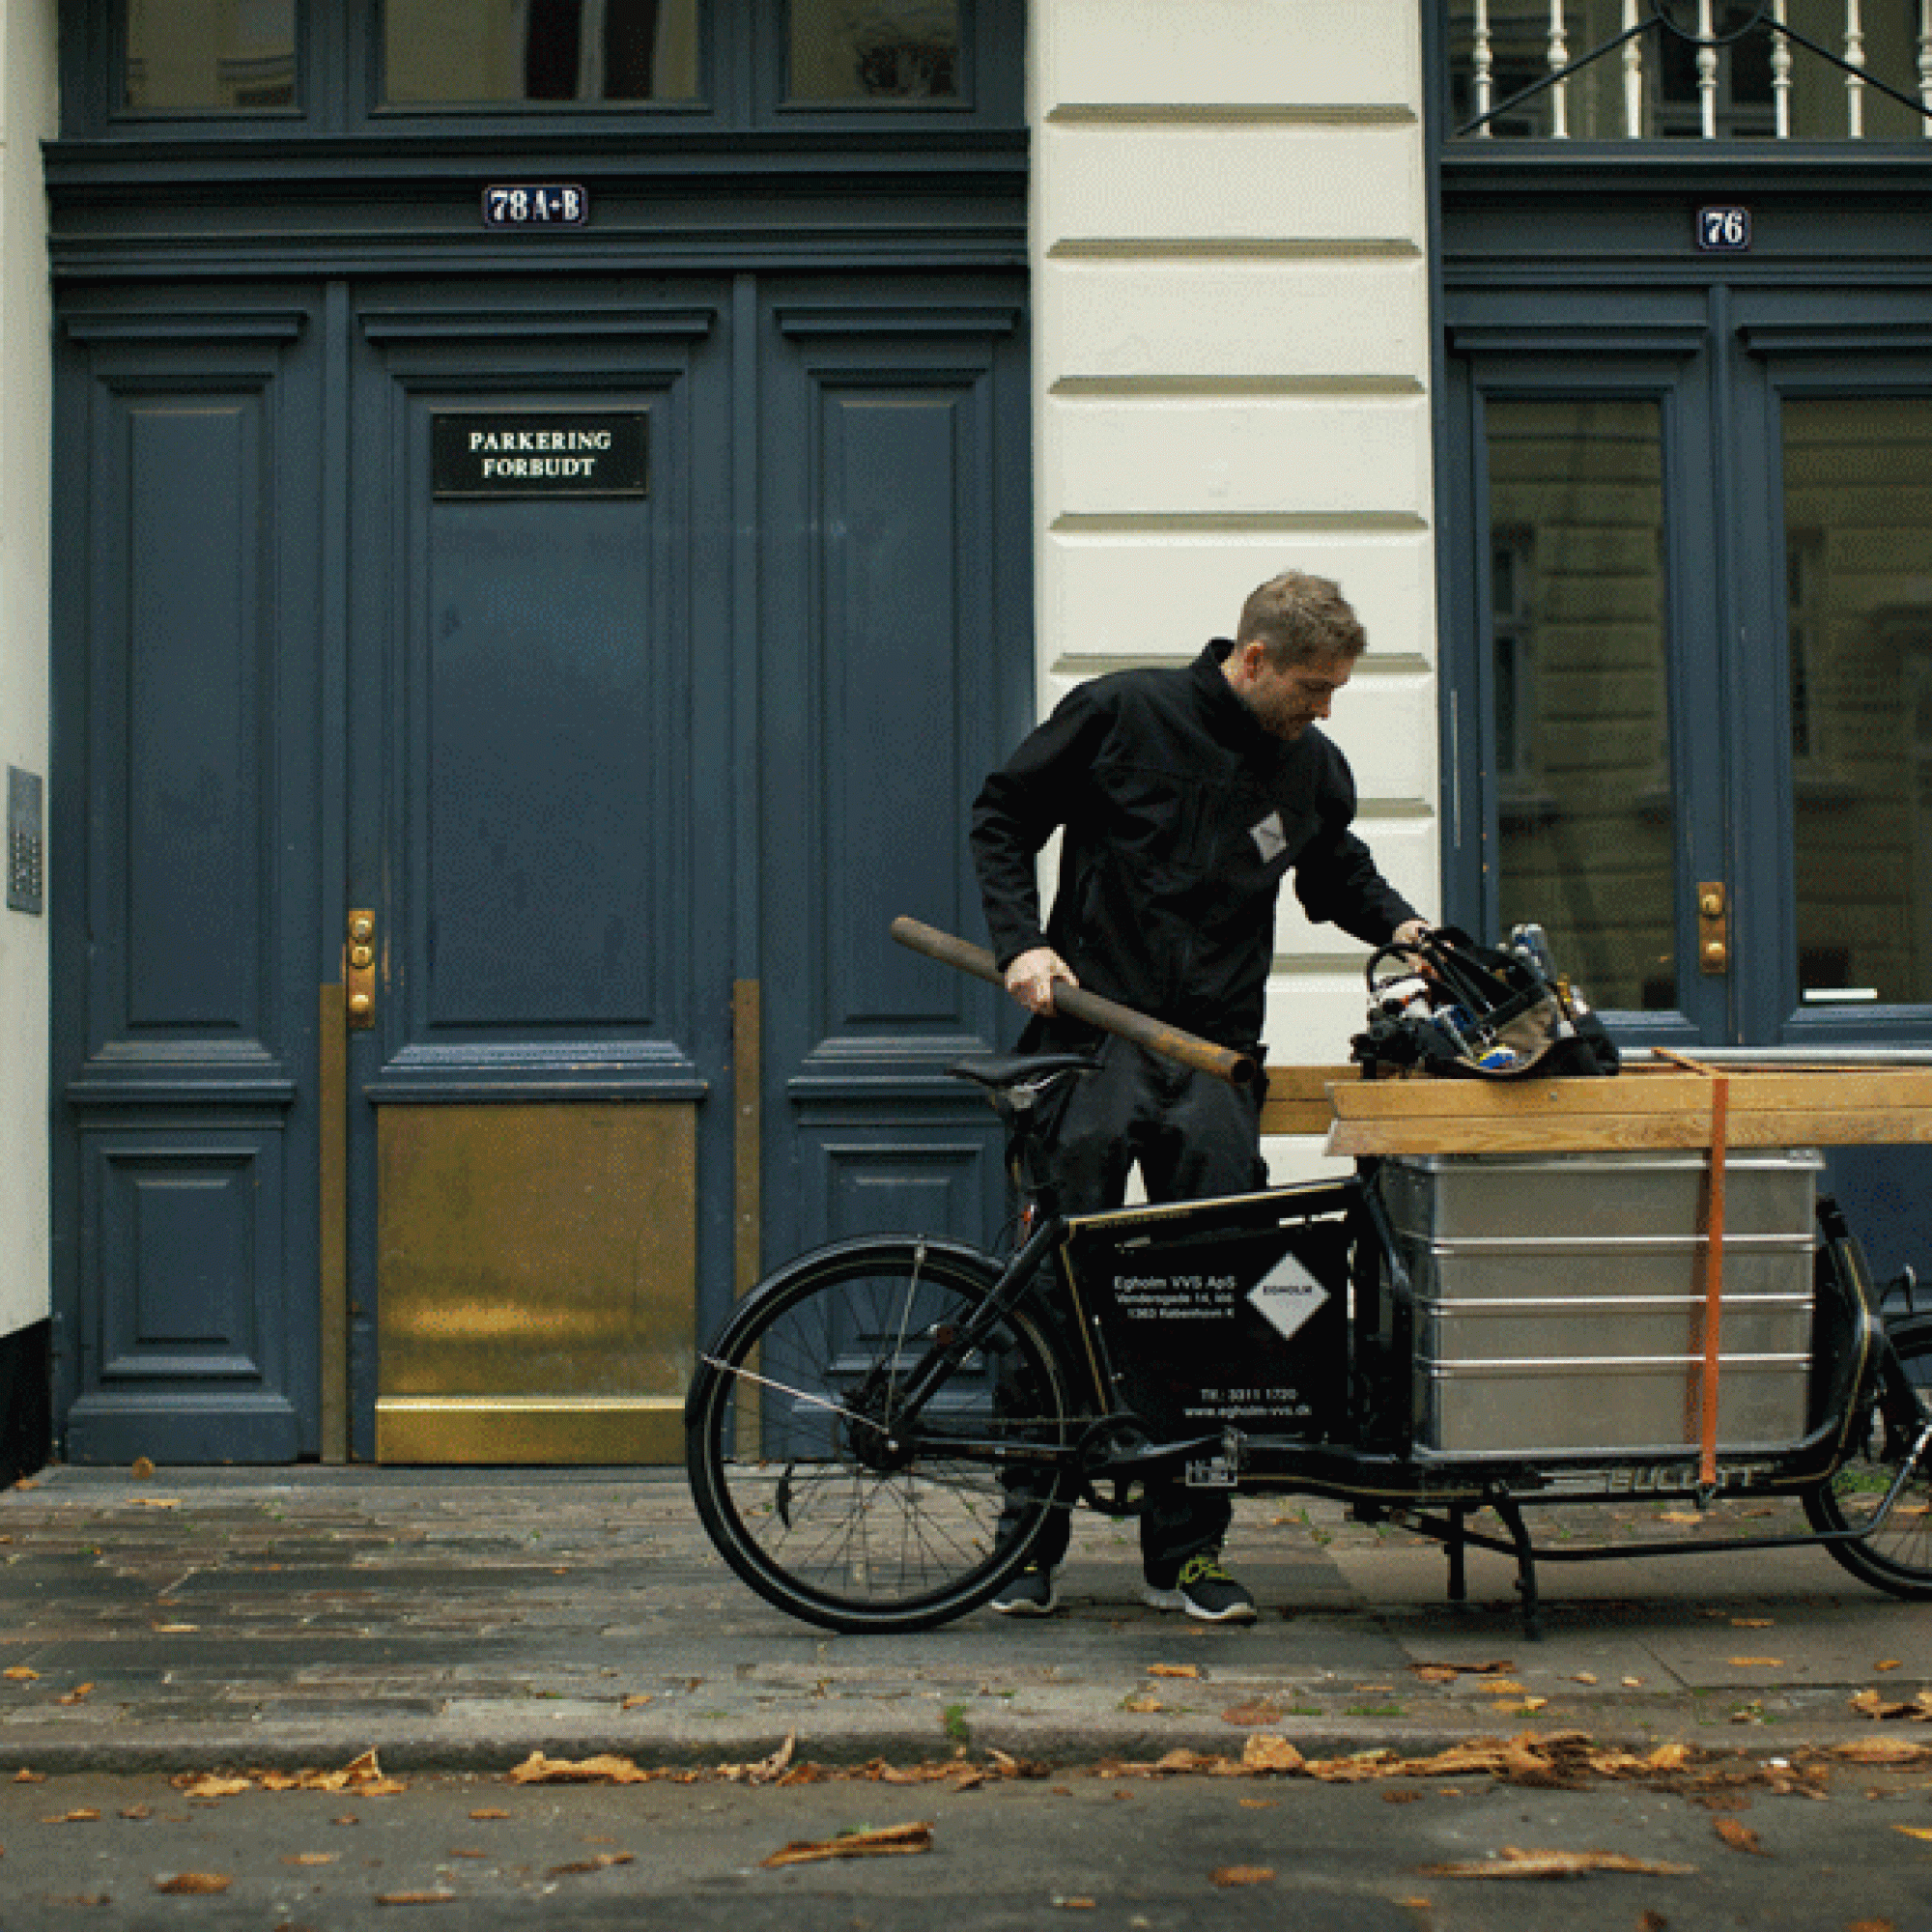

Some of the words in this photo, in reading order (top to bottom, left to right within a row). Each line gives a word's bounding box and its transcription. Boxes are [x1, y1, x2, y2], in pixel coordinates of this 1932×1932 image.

[1705, 213, 1743, 243] 76
[468, 431, 612, 451] PARKERING
[481, 457, 597, 478] FORBUDT
[1113, 1275, 1167, 1292] Egholm
[1171, 1275, 1203, 1290] VVS
